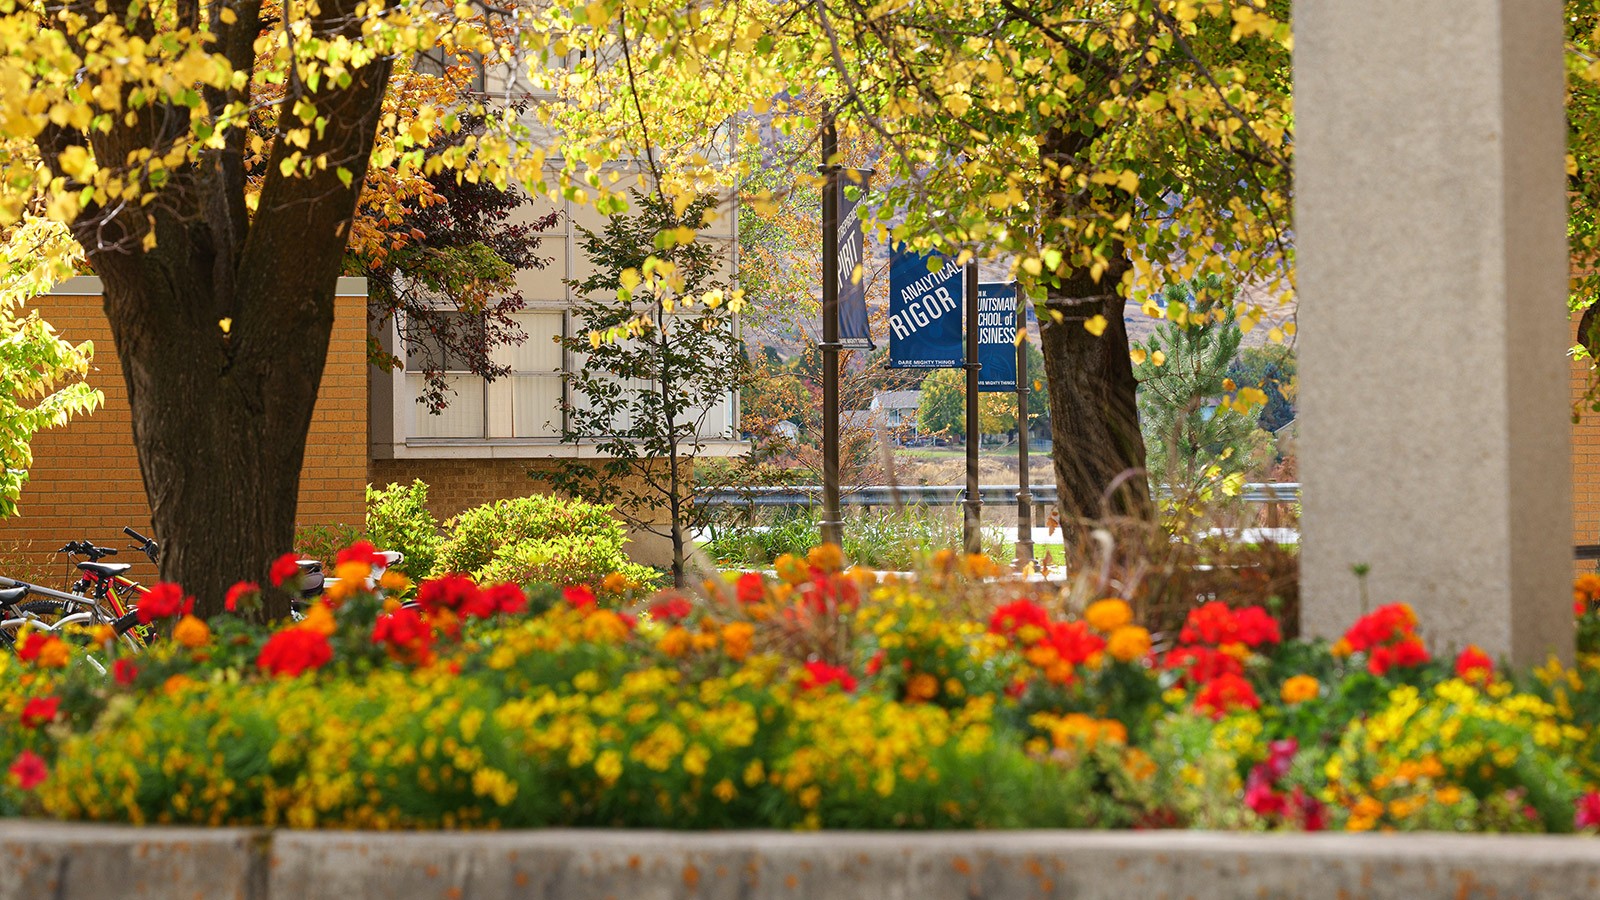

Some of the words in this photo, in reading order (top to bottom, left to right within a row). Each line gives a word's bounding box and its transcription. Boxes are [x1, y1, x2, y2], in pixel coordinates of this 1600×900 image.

[838, 229, 858, 295] PIRIT
[901, 260, 963, 304] ANALYTICAL
[890, 286, 957, 341] RIGOR
[978, 297, 1016, 312] UNTSMAN
[978, 312, 1002, 327] CHOOL
[1005, 312, 1014, 326] of
[978, 327, 1016, 344] USINESS
